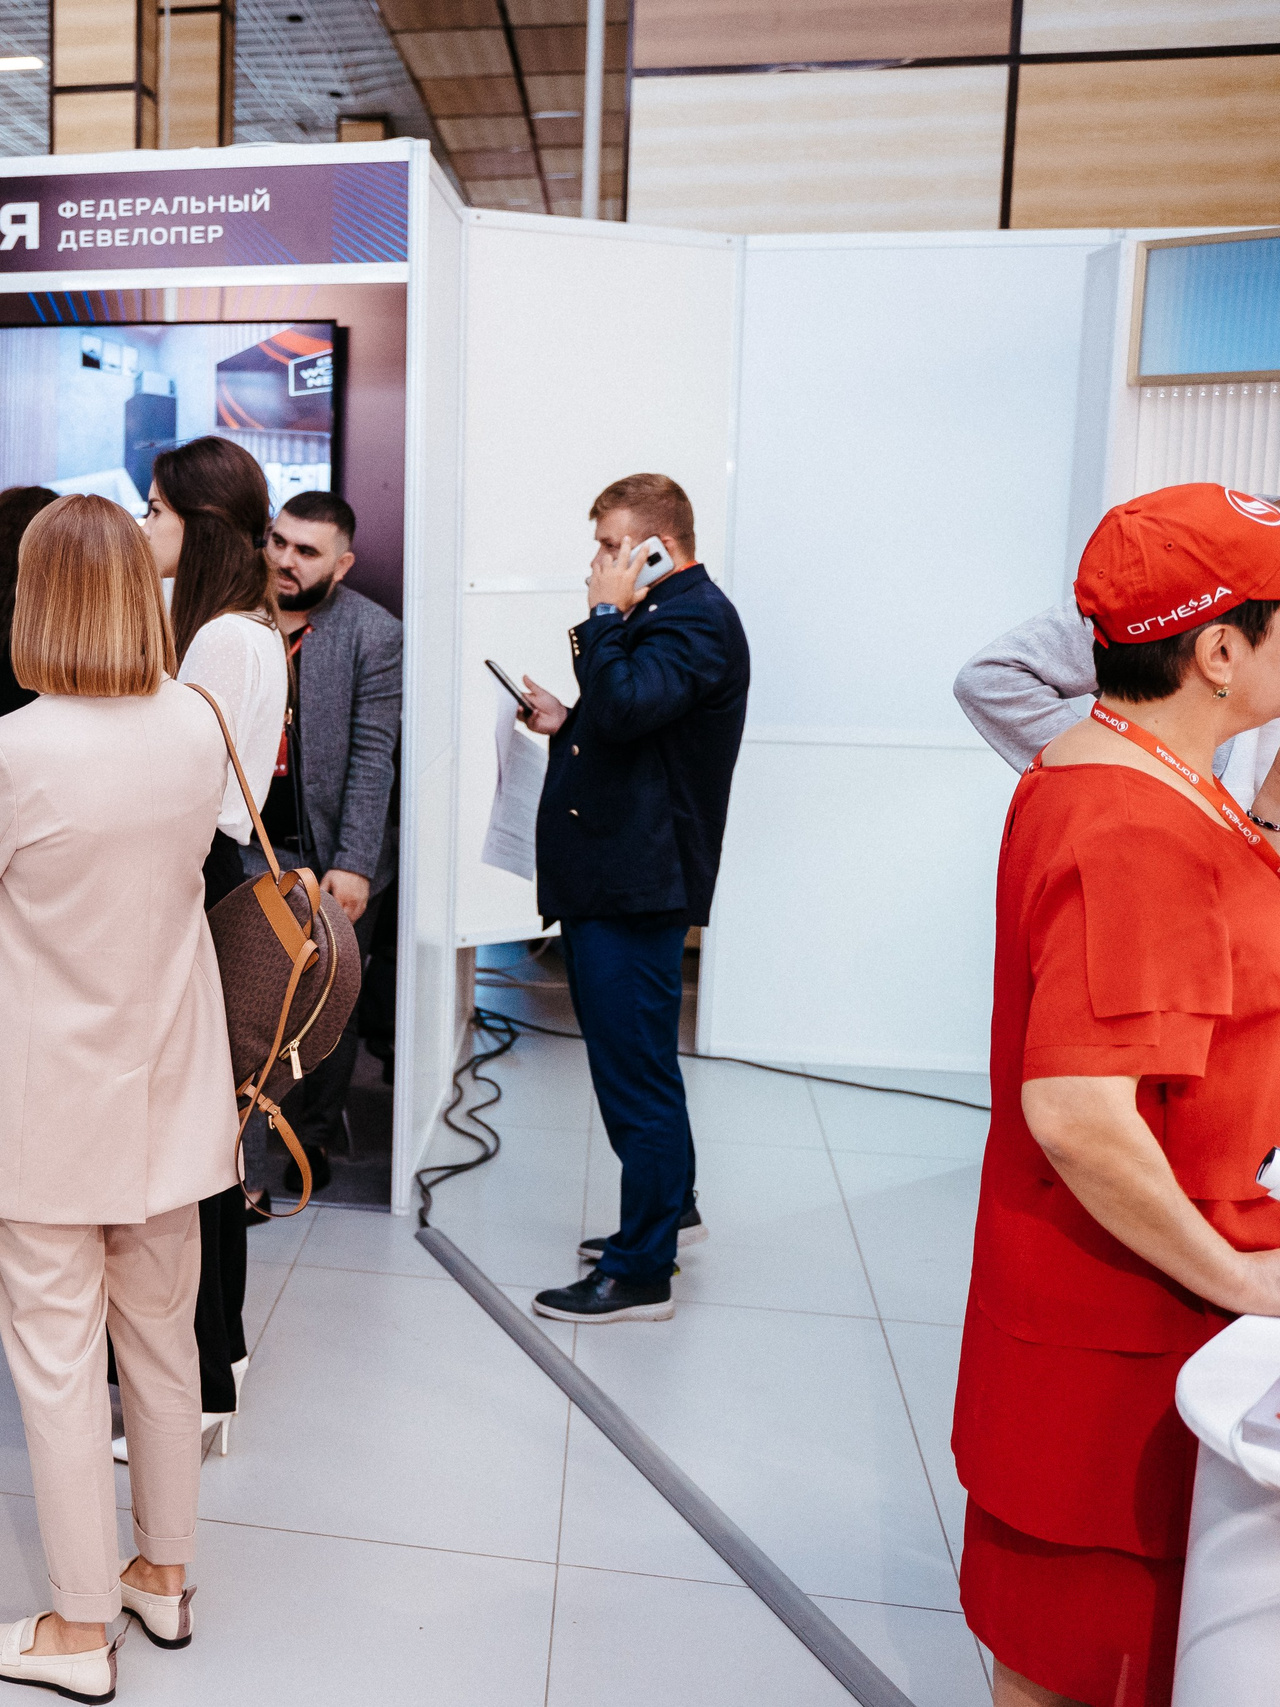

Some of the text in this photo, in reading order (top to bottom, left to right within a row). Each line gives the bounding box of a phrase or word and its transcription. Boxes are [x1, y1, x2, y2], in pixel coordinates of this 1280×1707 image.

[57, 187, 271, 221] ФЕДЕРАЛЬНЫЙ
[57, 224, 224, 252] ДЕВЕЛОПЕР
[1126, 586, 1232, 635] ОГНЕЗА
